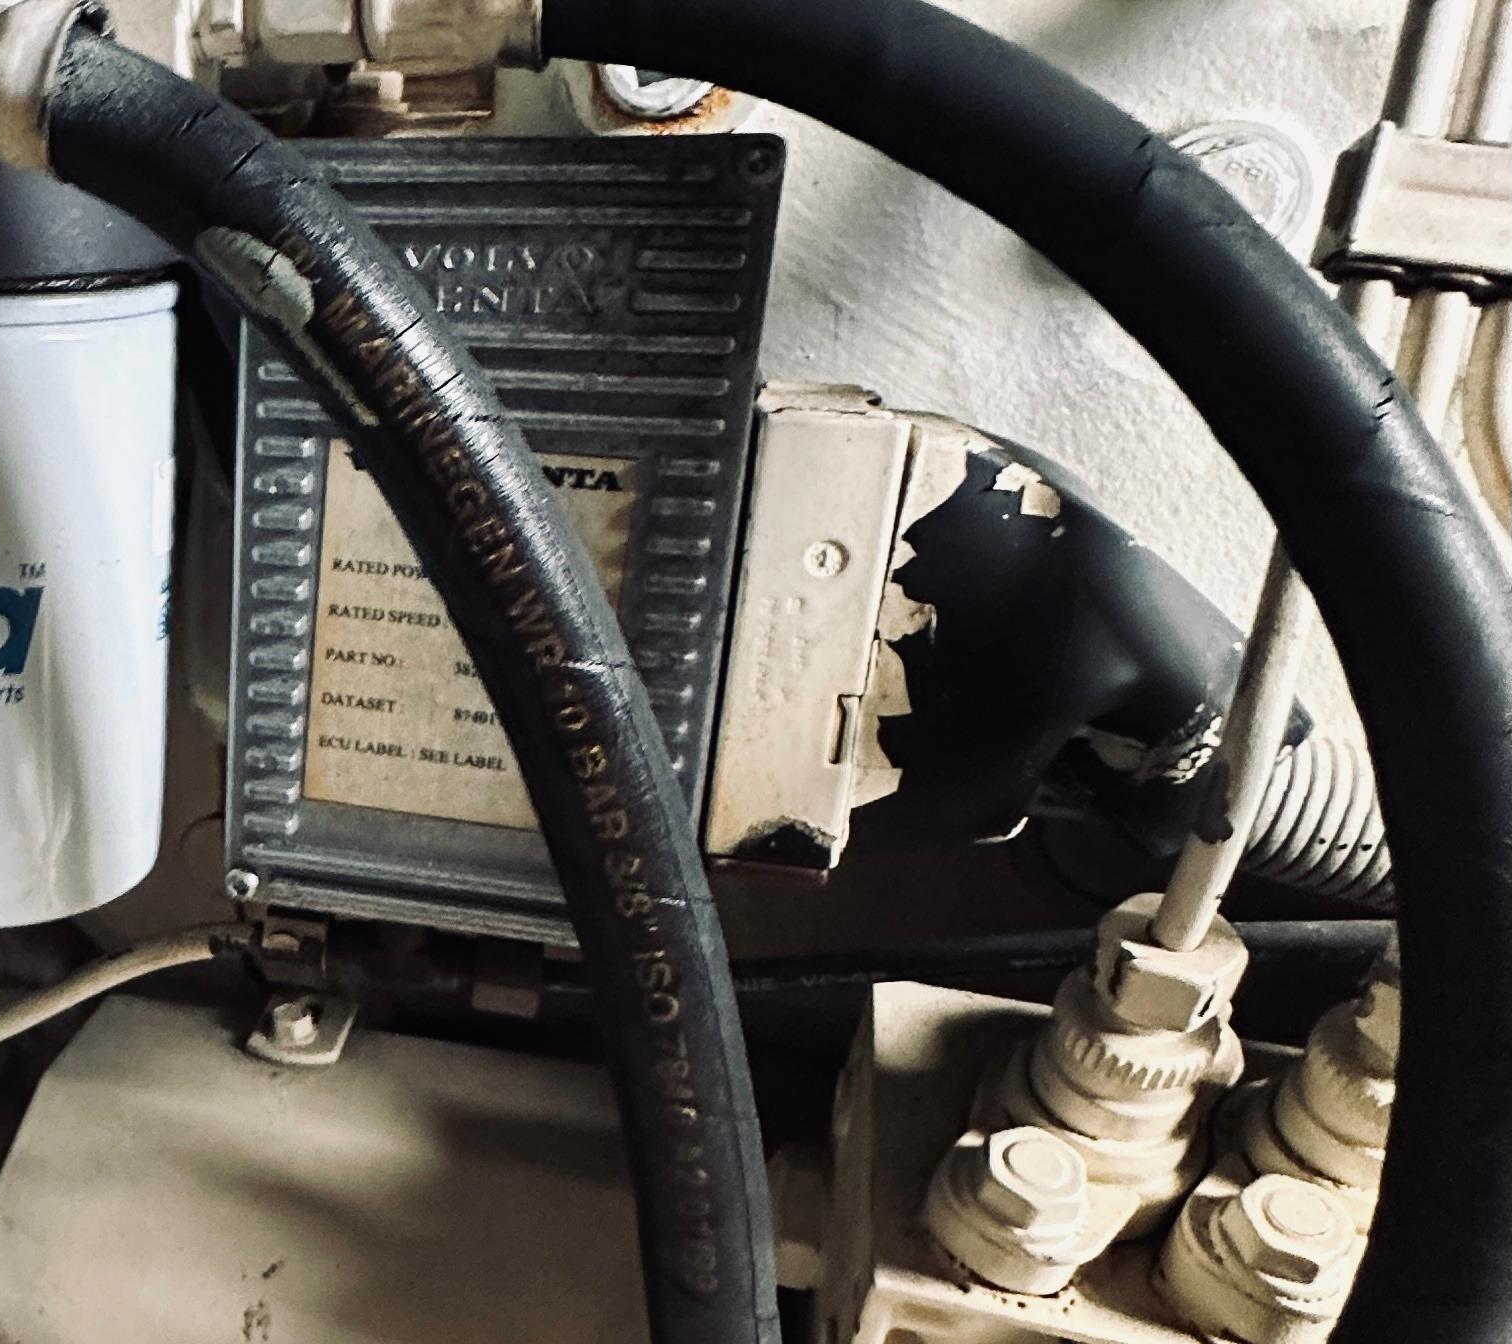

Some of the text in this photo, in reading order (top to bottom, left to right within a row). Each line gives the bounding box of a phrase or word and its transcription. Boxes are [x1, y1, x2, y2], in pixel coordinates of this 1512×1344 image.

[434, 285, 596, 314] ENTA
[541, 465, 624, 492] NTA
[331, 557, 388, 576] RATED
[327, 603, 441, 629] RATED SPEED
[325, 648, 369, 666] PART
[321, 692, 397, 713] DATASET
[318, 733, 507, 772] ECU LABEL SEE LABEL
[634, 949, 680, 1023] ISO
